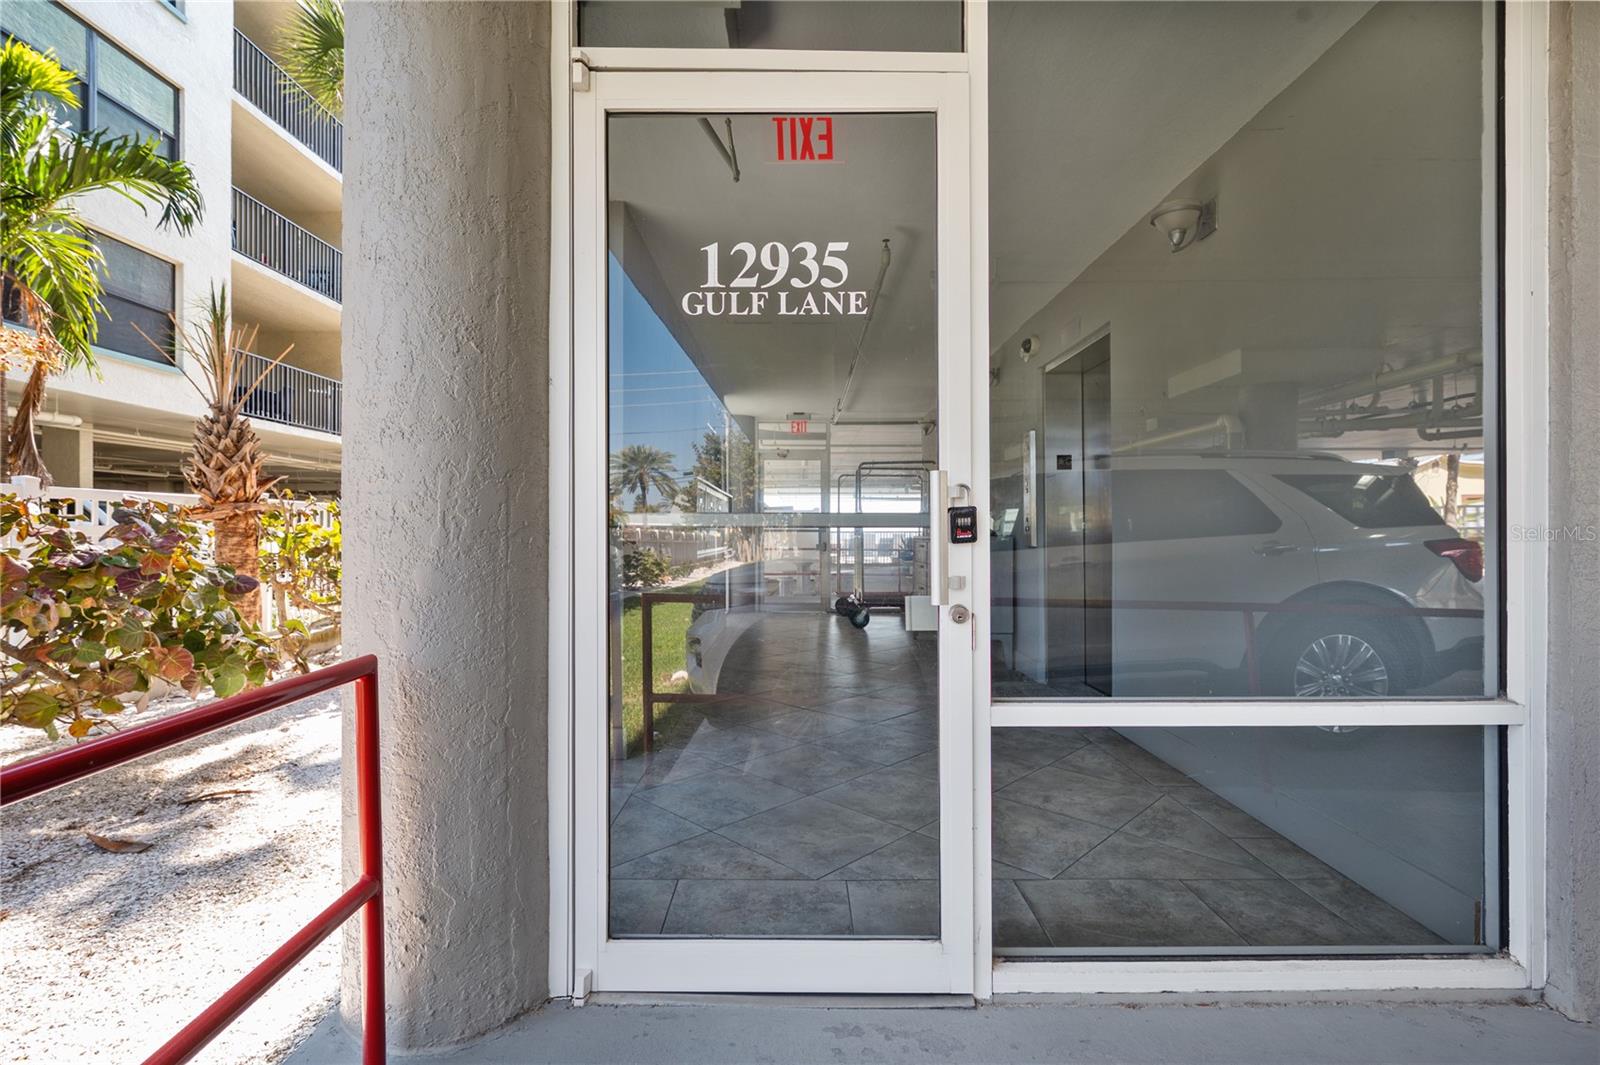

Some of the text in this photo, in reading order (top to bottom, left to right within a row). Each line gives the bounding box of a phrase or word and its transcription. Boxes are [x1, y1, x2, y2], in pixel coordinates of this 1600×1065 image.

[699, 241, 849, 289] 12935
[681, 291, 868, 316] GULF LANE
[791, 421, 808, 433] EXIT
